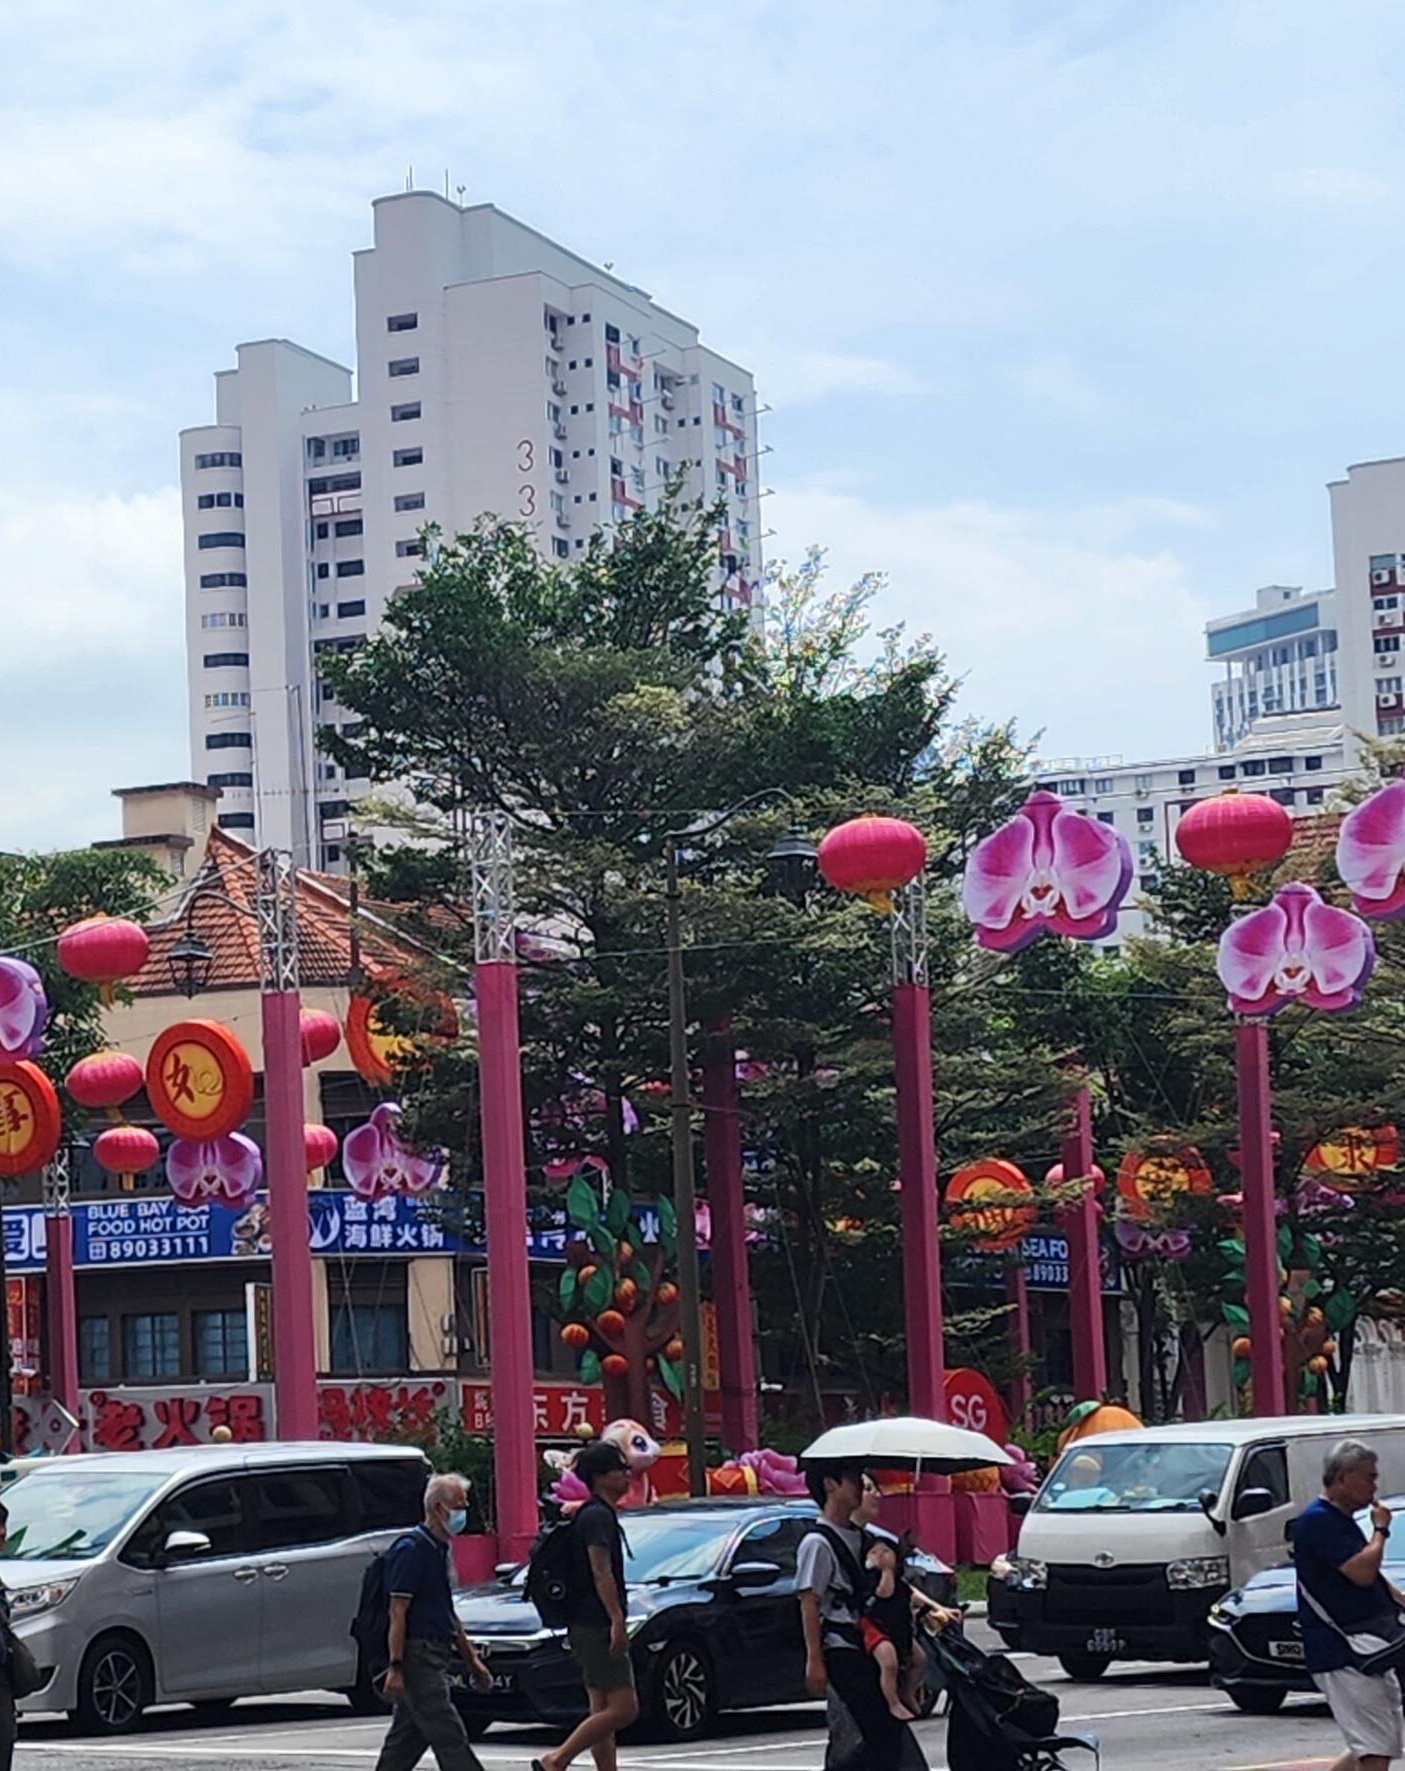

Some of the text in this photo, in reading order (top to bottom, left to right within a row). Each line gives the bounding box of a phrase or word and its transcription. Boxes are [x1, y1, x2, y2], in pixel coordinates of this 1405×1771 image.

[87, 1205, 129, 1220] BLUE
[137, 1201, 171, 1217] BAY
[87, 1214, 210, 1236] FOOD HOT POT
[345, 1223, 445, 1249] 海鲜火锅
[109, 1236, 210, 1259] 89033111
[950, 1393, 987, 1431] SG
